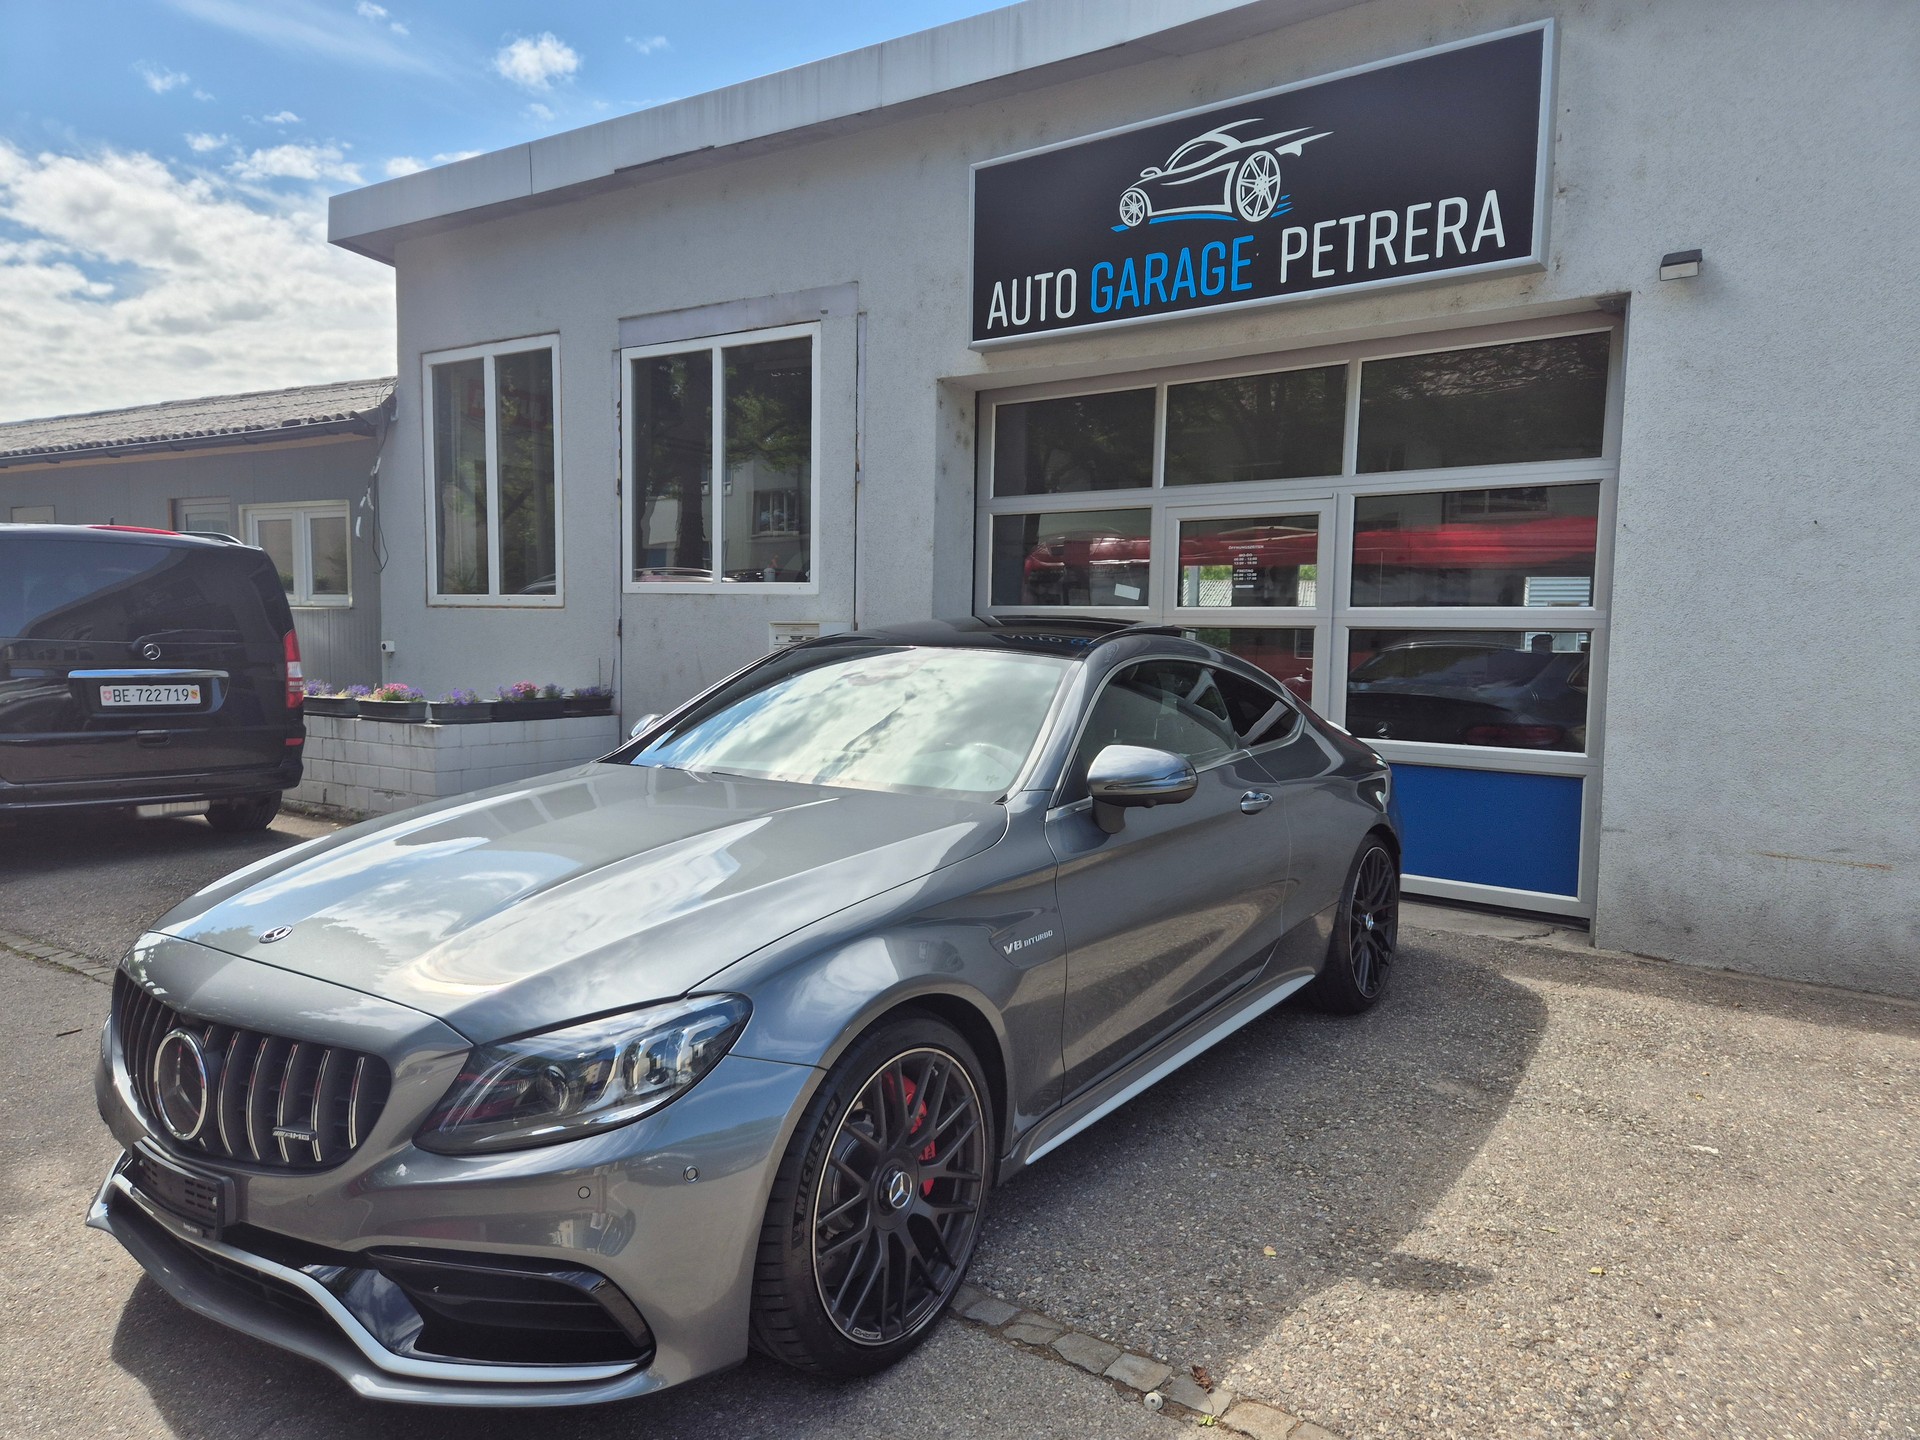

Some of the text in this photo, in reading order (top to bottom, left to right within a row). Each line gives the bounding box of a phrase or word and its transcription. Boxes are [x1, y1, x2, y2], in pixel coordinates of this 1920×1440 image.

[986, 189, 1506, 330] AUTO GARAGE PETRERA
[1003, 939, 1023, 955] V8
[795, 1097, 839, 1215] MICHELIN
